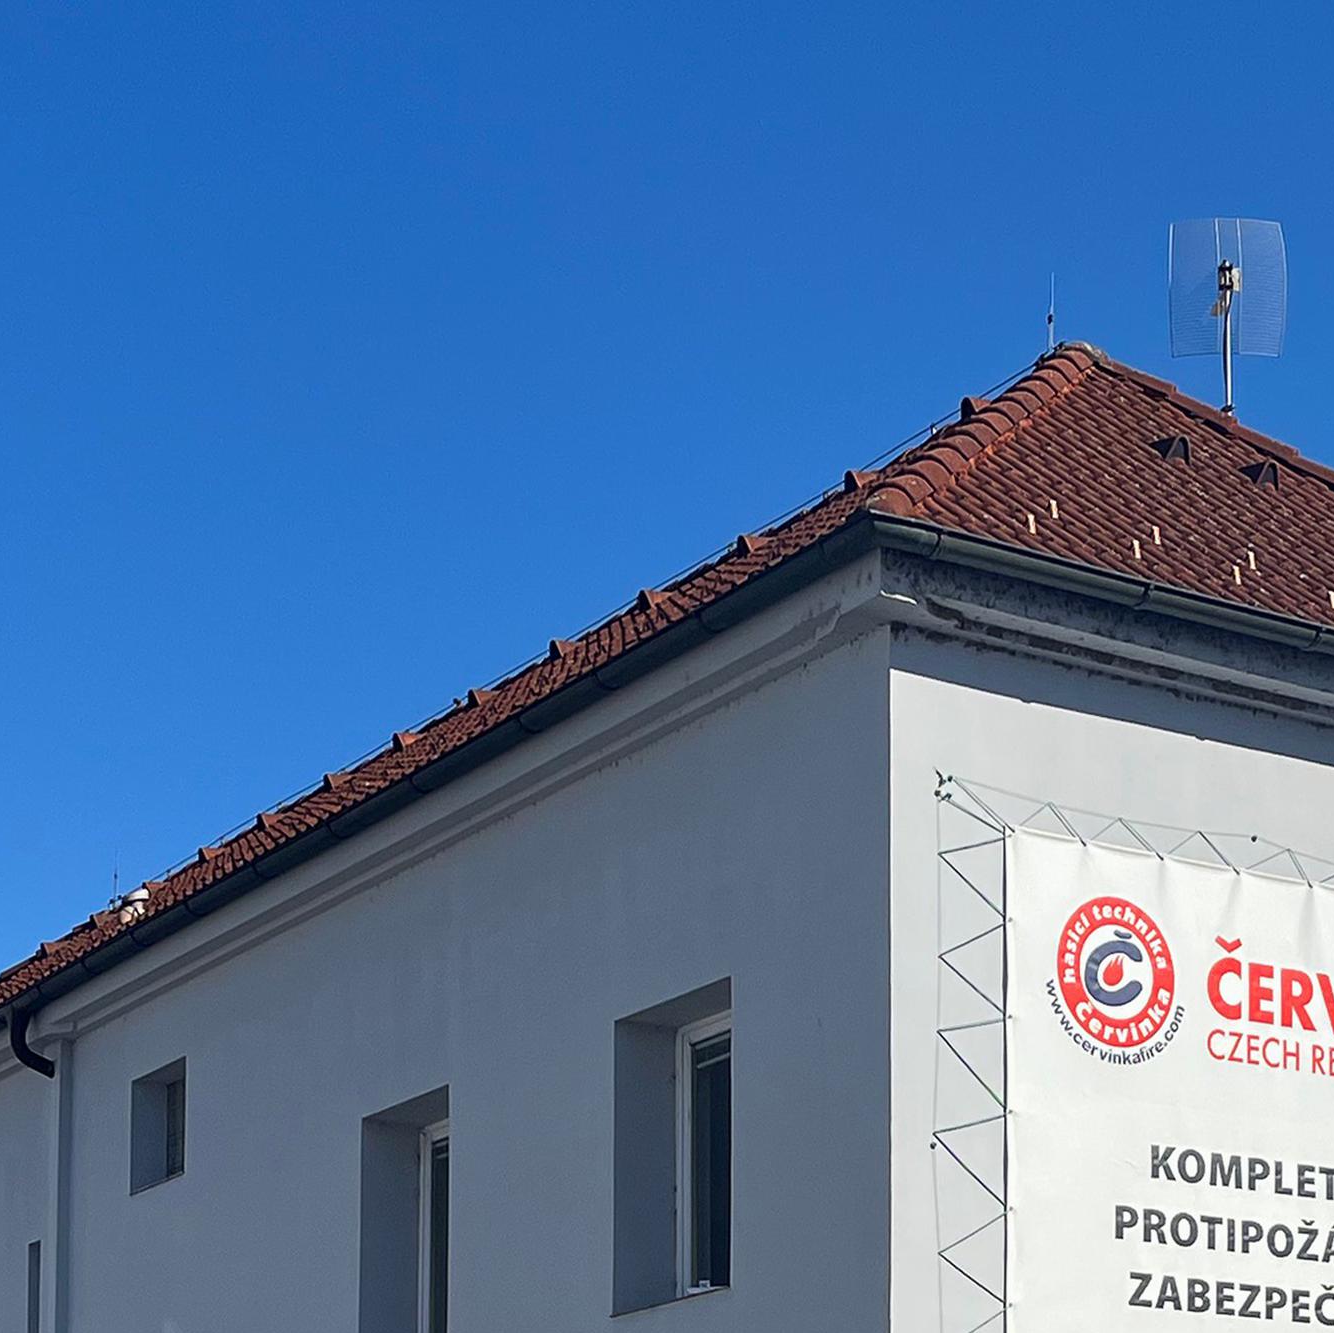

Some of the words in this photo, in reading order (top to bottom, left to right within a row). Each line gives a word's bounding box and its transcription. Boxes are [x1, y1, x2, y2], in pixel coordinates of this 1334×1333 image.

[1092, 904, 1168, 969] technika
[1045, 978, 1186, 1066] www.cervinkafire.com
[1206, 1028, 1301, 1072] CZECH
